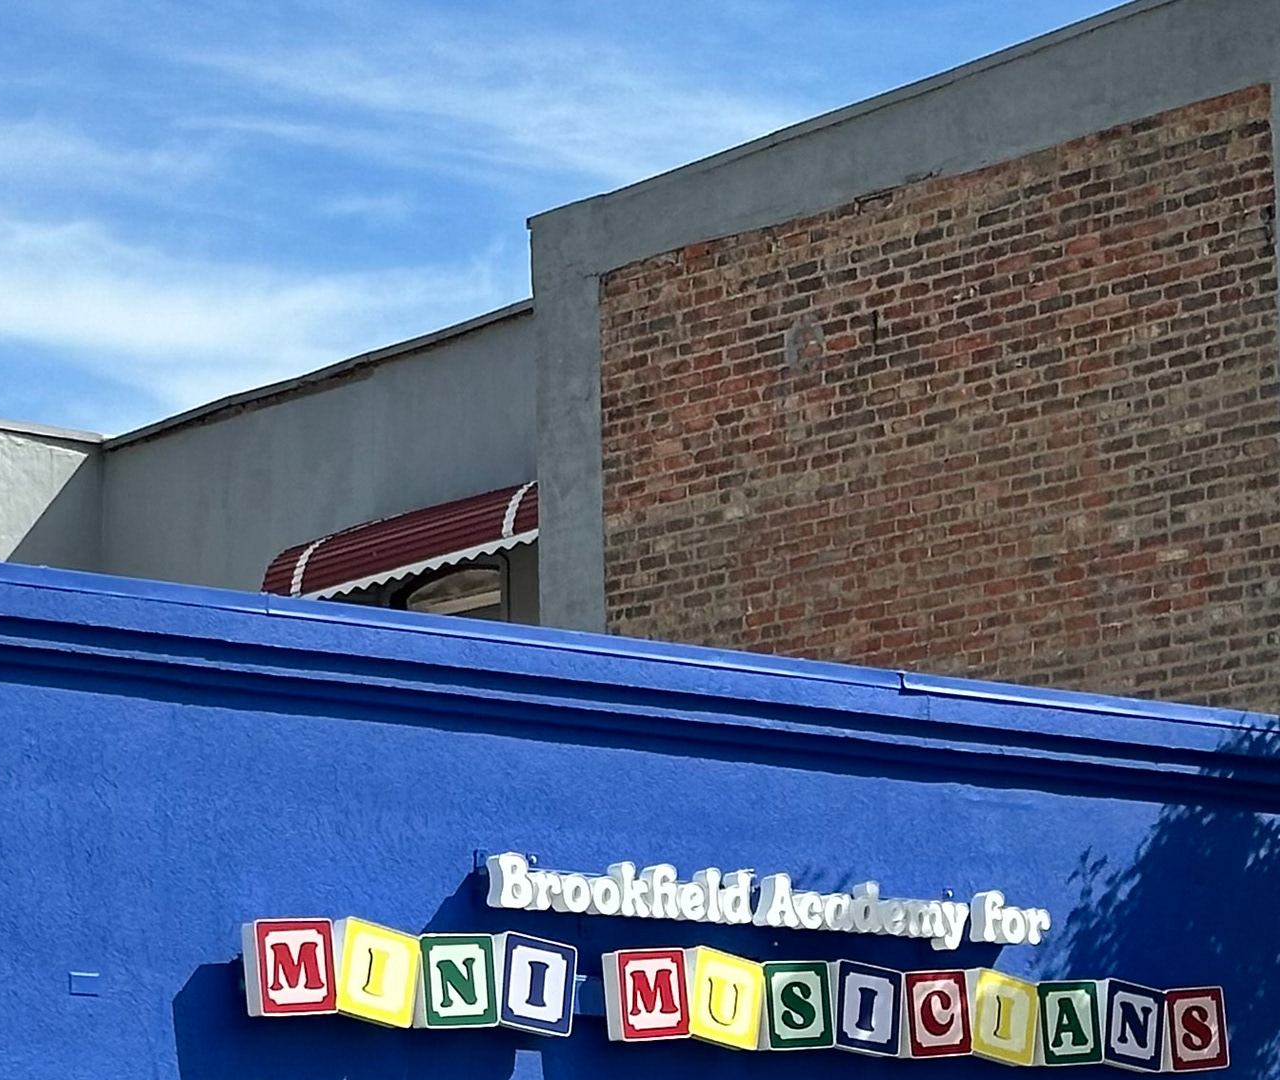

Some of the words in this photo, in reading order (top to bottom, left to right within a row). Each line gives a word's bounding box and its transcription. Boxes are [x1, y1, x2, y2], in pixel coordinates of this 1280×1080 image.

[487, 851, 753, 924] Brookfield
[753, 872, 970, 950] Academy
[970, 889, 1051, 946] for
[268, 940, 554, 1009] MINI
[628, 968, 1217, 1053] MUSICIANS
